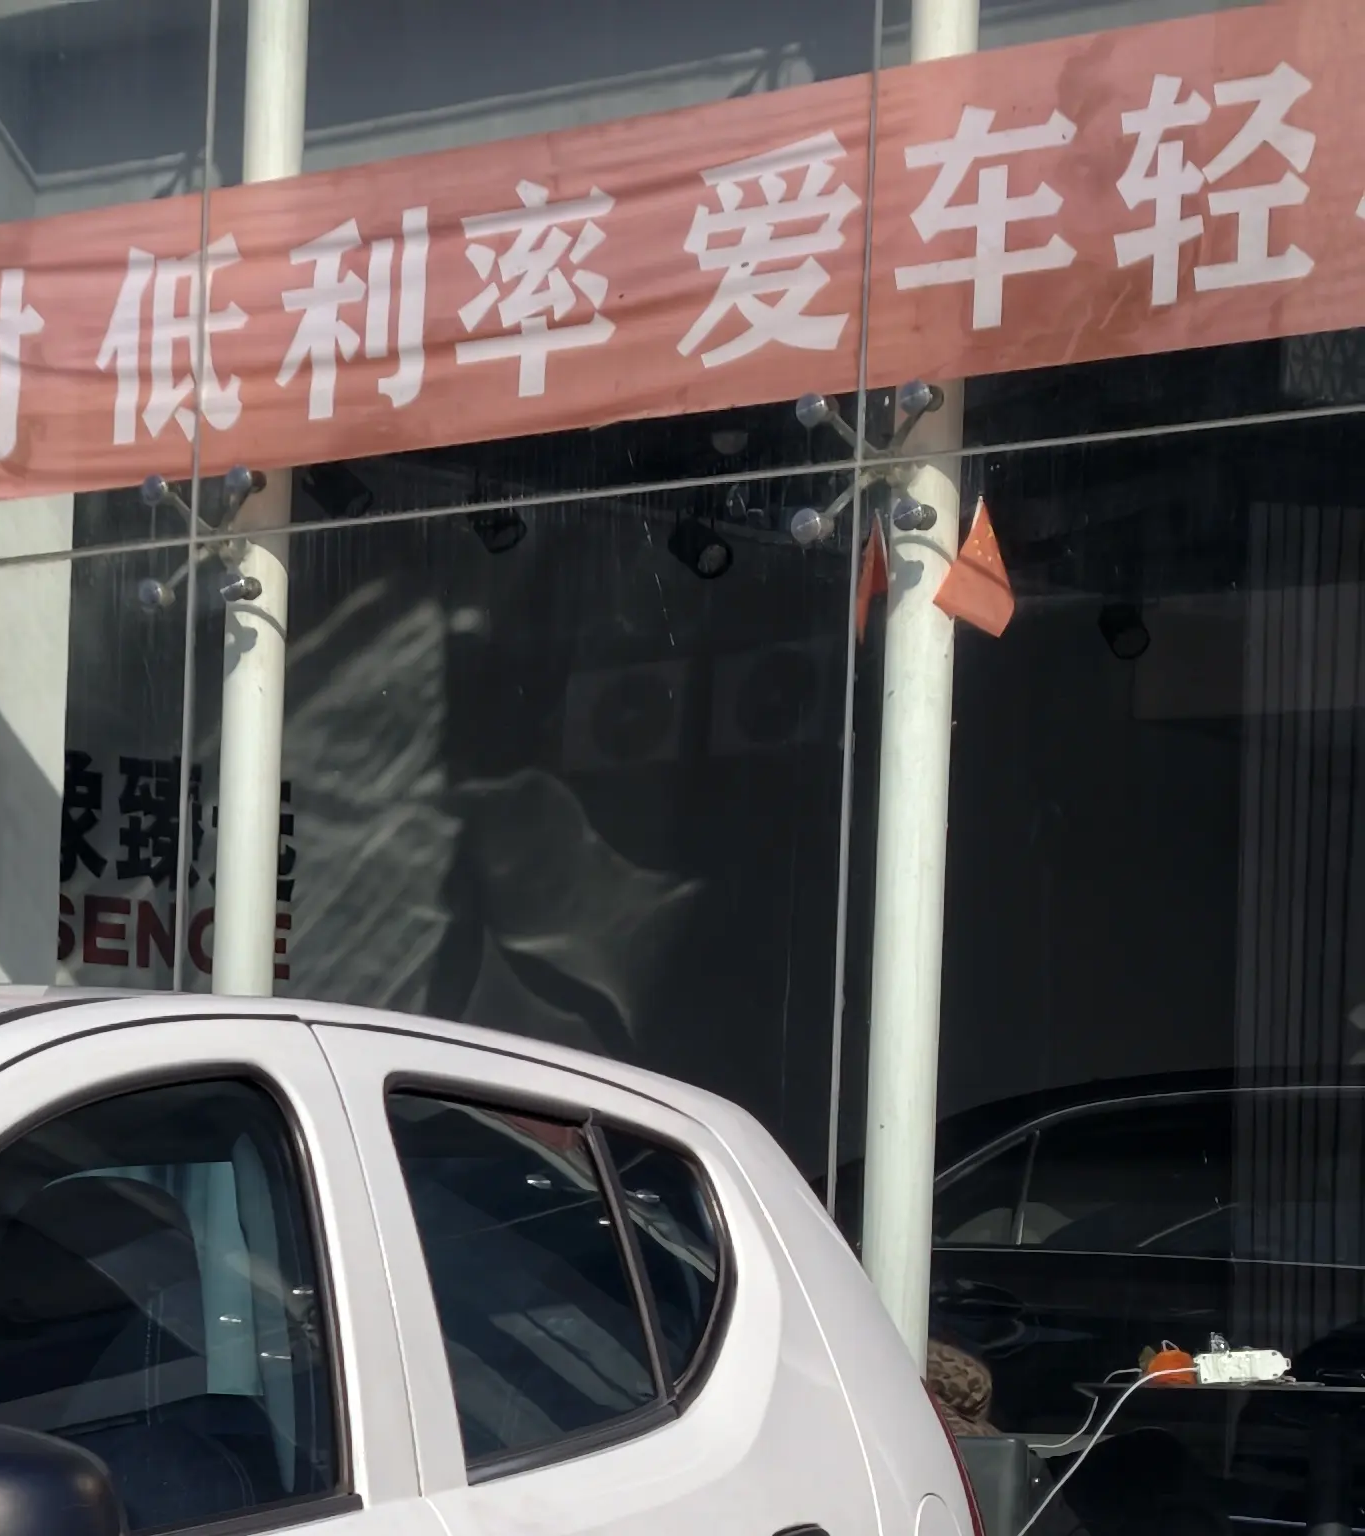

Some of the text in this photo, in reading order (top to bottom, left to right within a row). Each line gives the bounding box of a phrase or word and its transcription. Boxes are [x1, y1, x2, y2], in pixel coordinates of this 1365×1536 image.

[96, 179, 616, 445] 低利率
[676, 61, 1365, 369] 爱车轻
